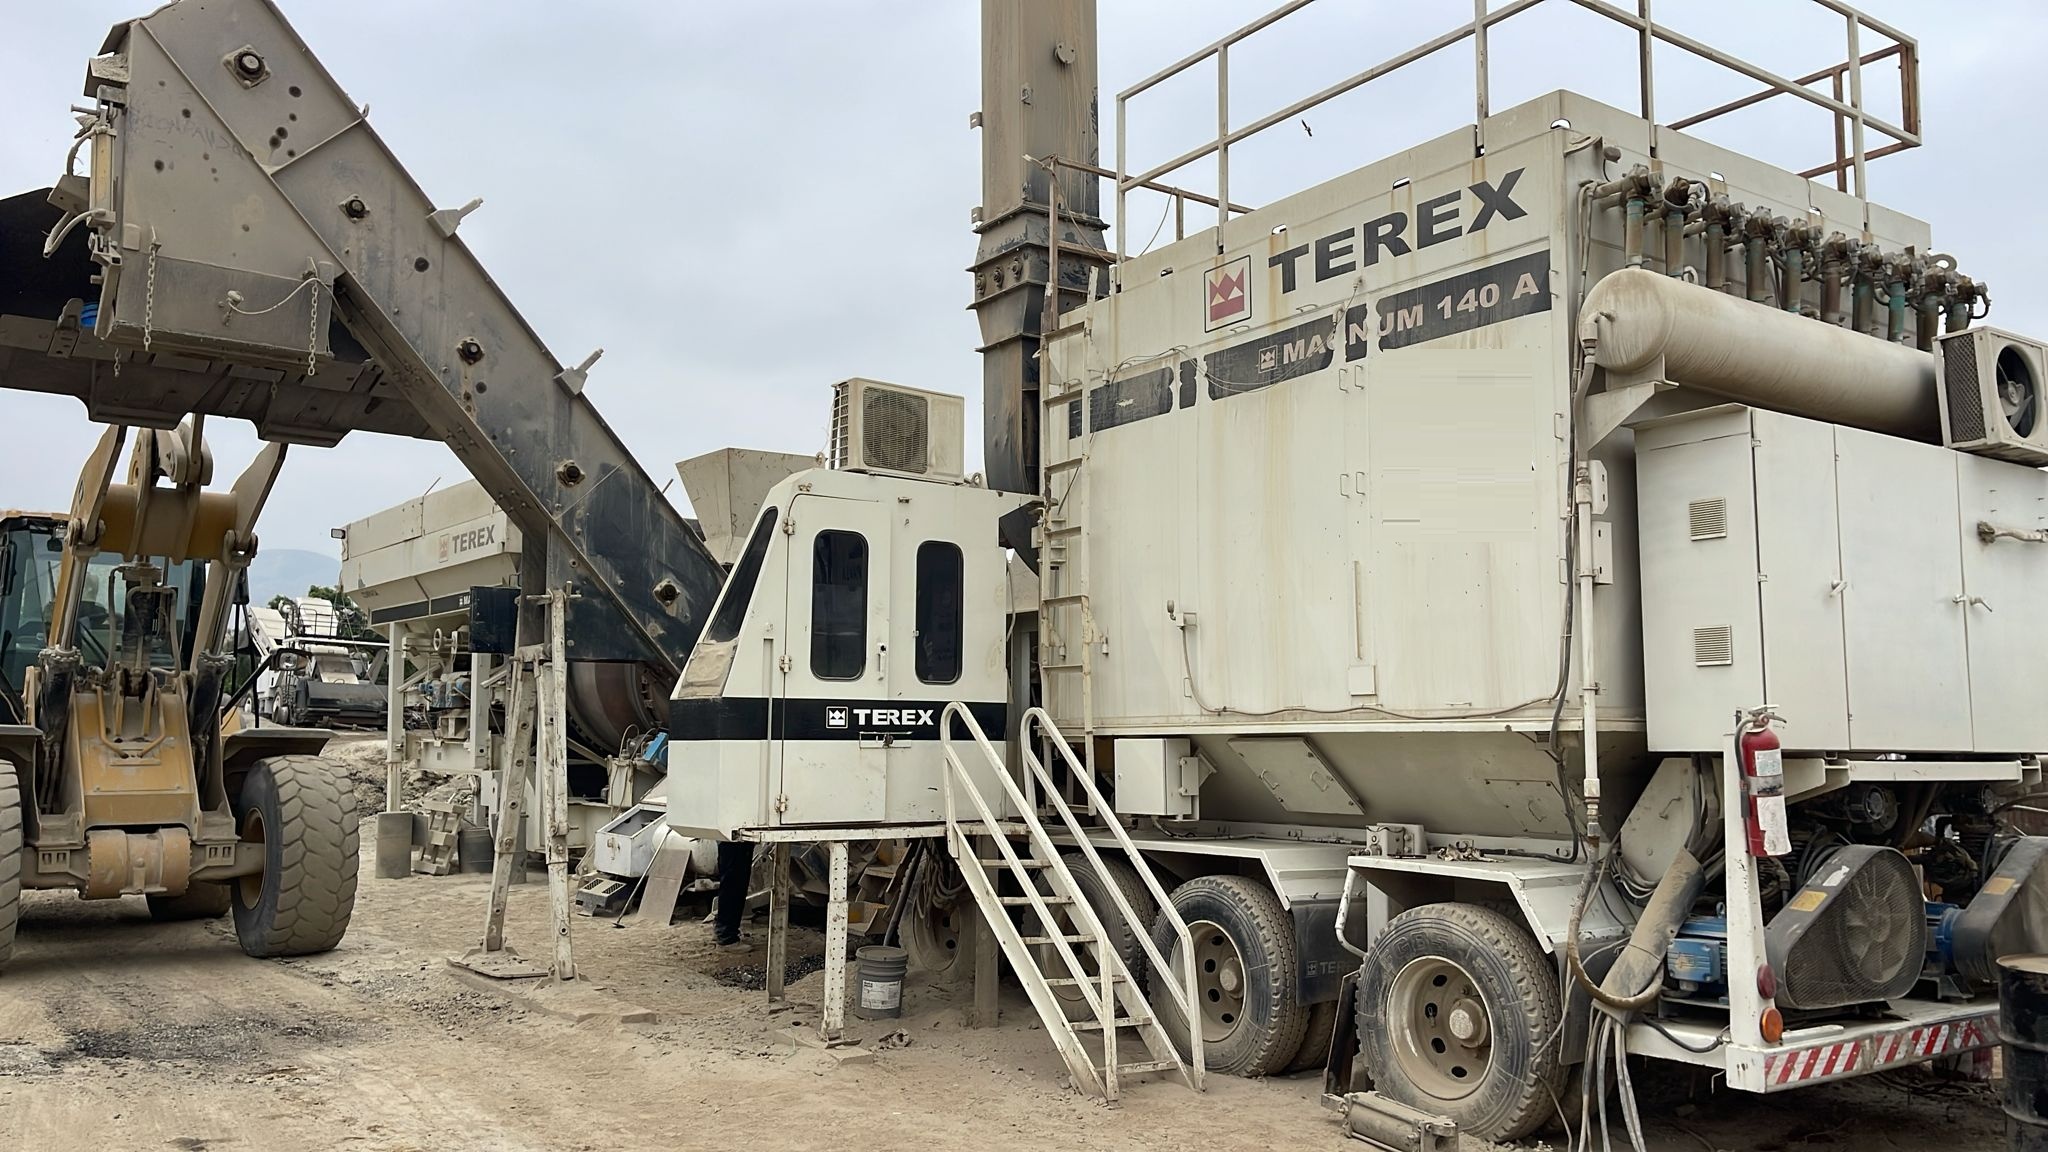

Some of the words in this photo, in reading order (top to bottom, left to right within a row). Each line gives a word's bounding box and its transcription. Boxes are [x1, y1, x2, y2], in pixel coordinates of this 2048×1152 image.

[1268, 167, 1528, 295] TEREX
[1437, 283, 1500, 320] 140
[1512, 272, 1540, 300] A
[452, 524, 496, 554] TEREX
[853, 708, 934, 726] TEREX
